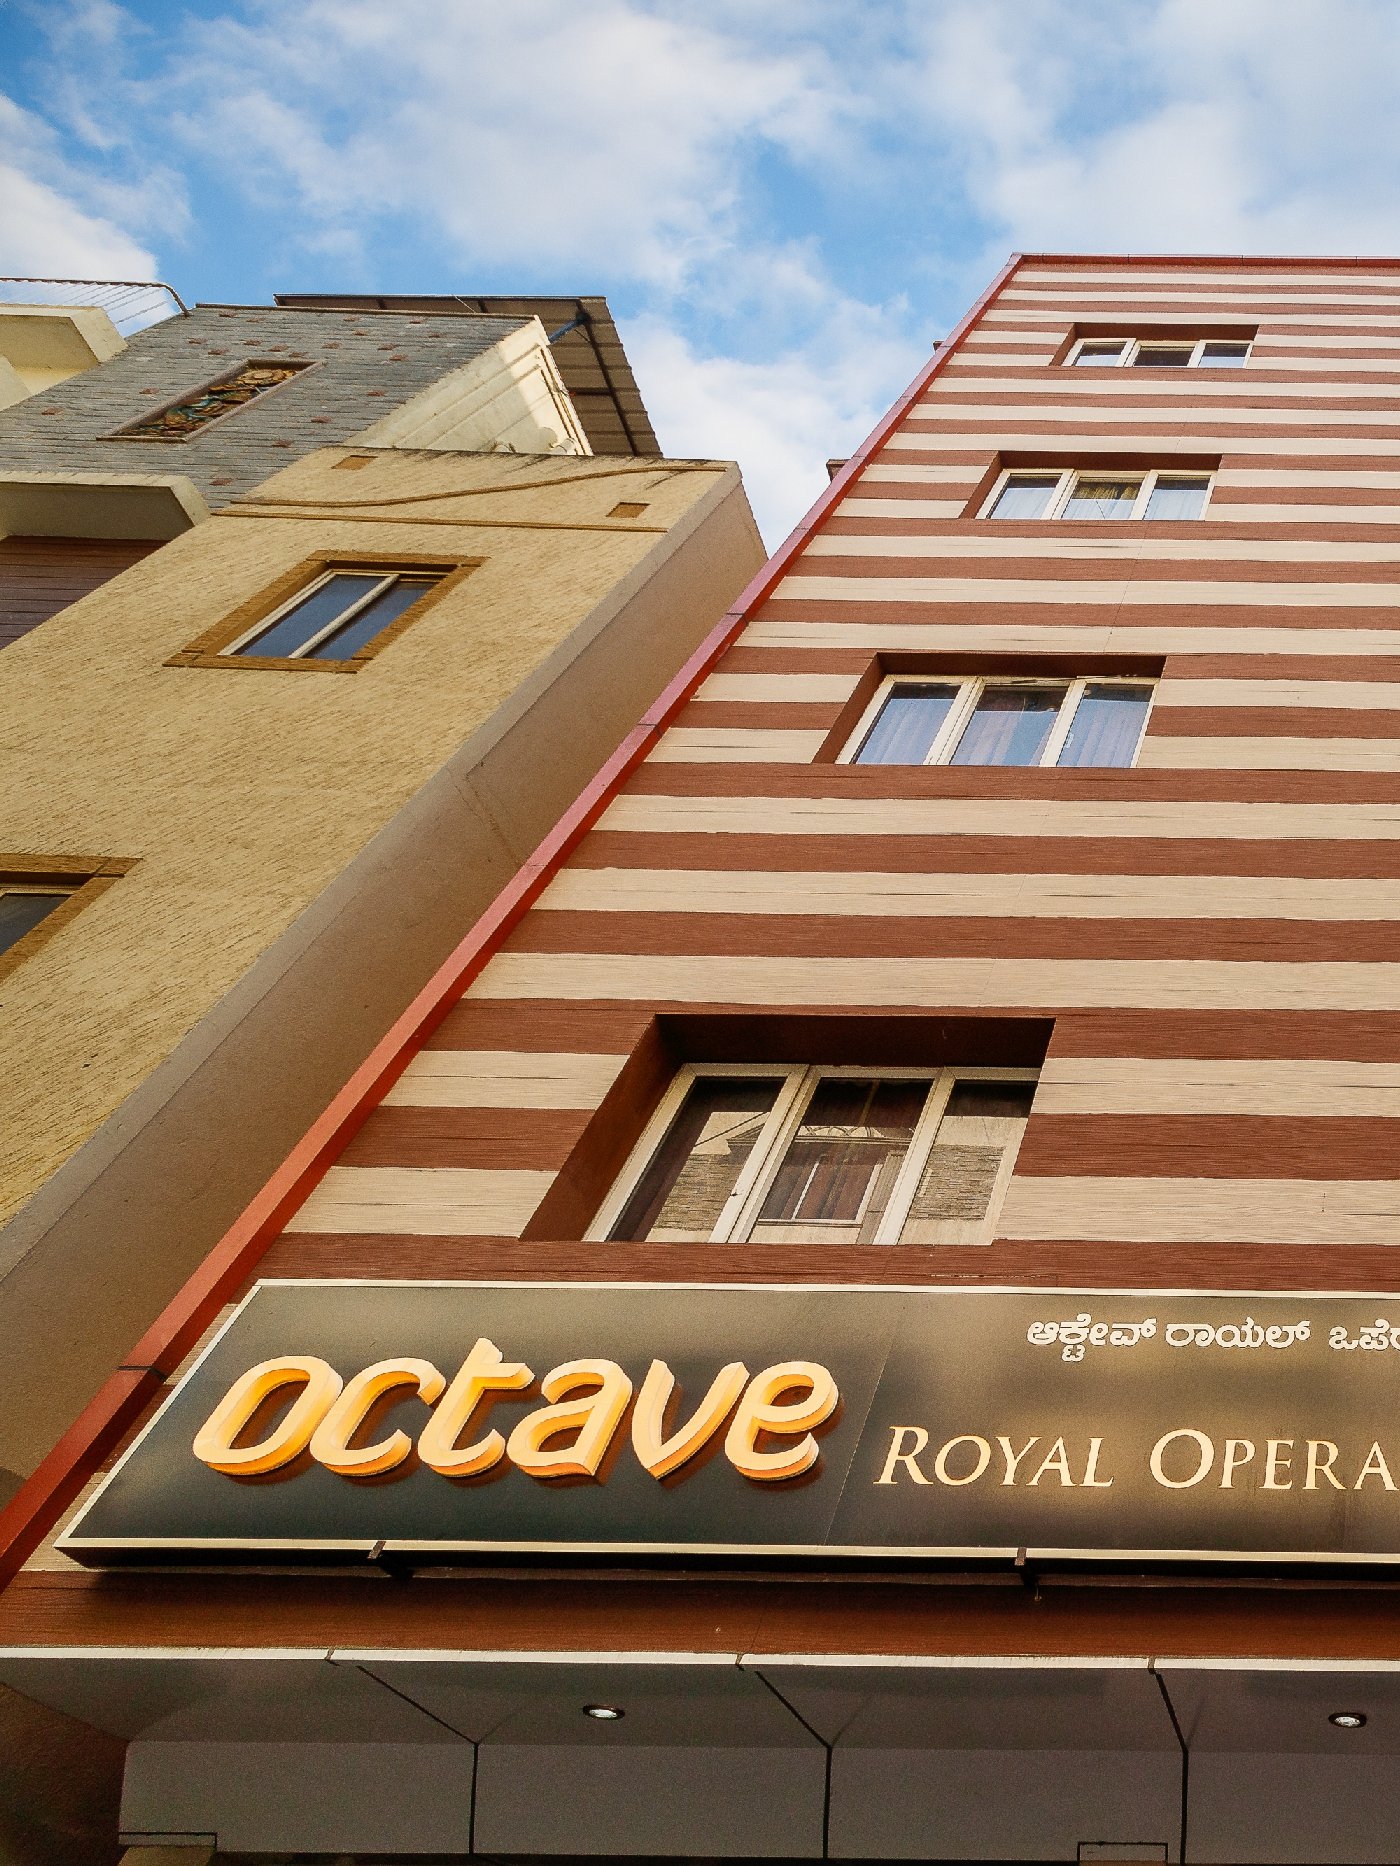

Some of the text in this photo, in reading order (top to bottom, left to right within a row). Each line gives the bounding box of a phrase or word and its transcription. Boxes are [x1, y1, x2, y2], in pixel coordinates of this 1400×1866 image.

[1164, 1316, 1312, 1349] ರಾಯಲ್
[192, 1337, 839, 1482] octave
[873, 1425, 1400, 1492] ROYAL OPERA
